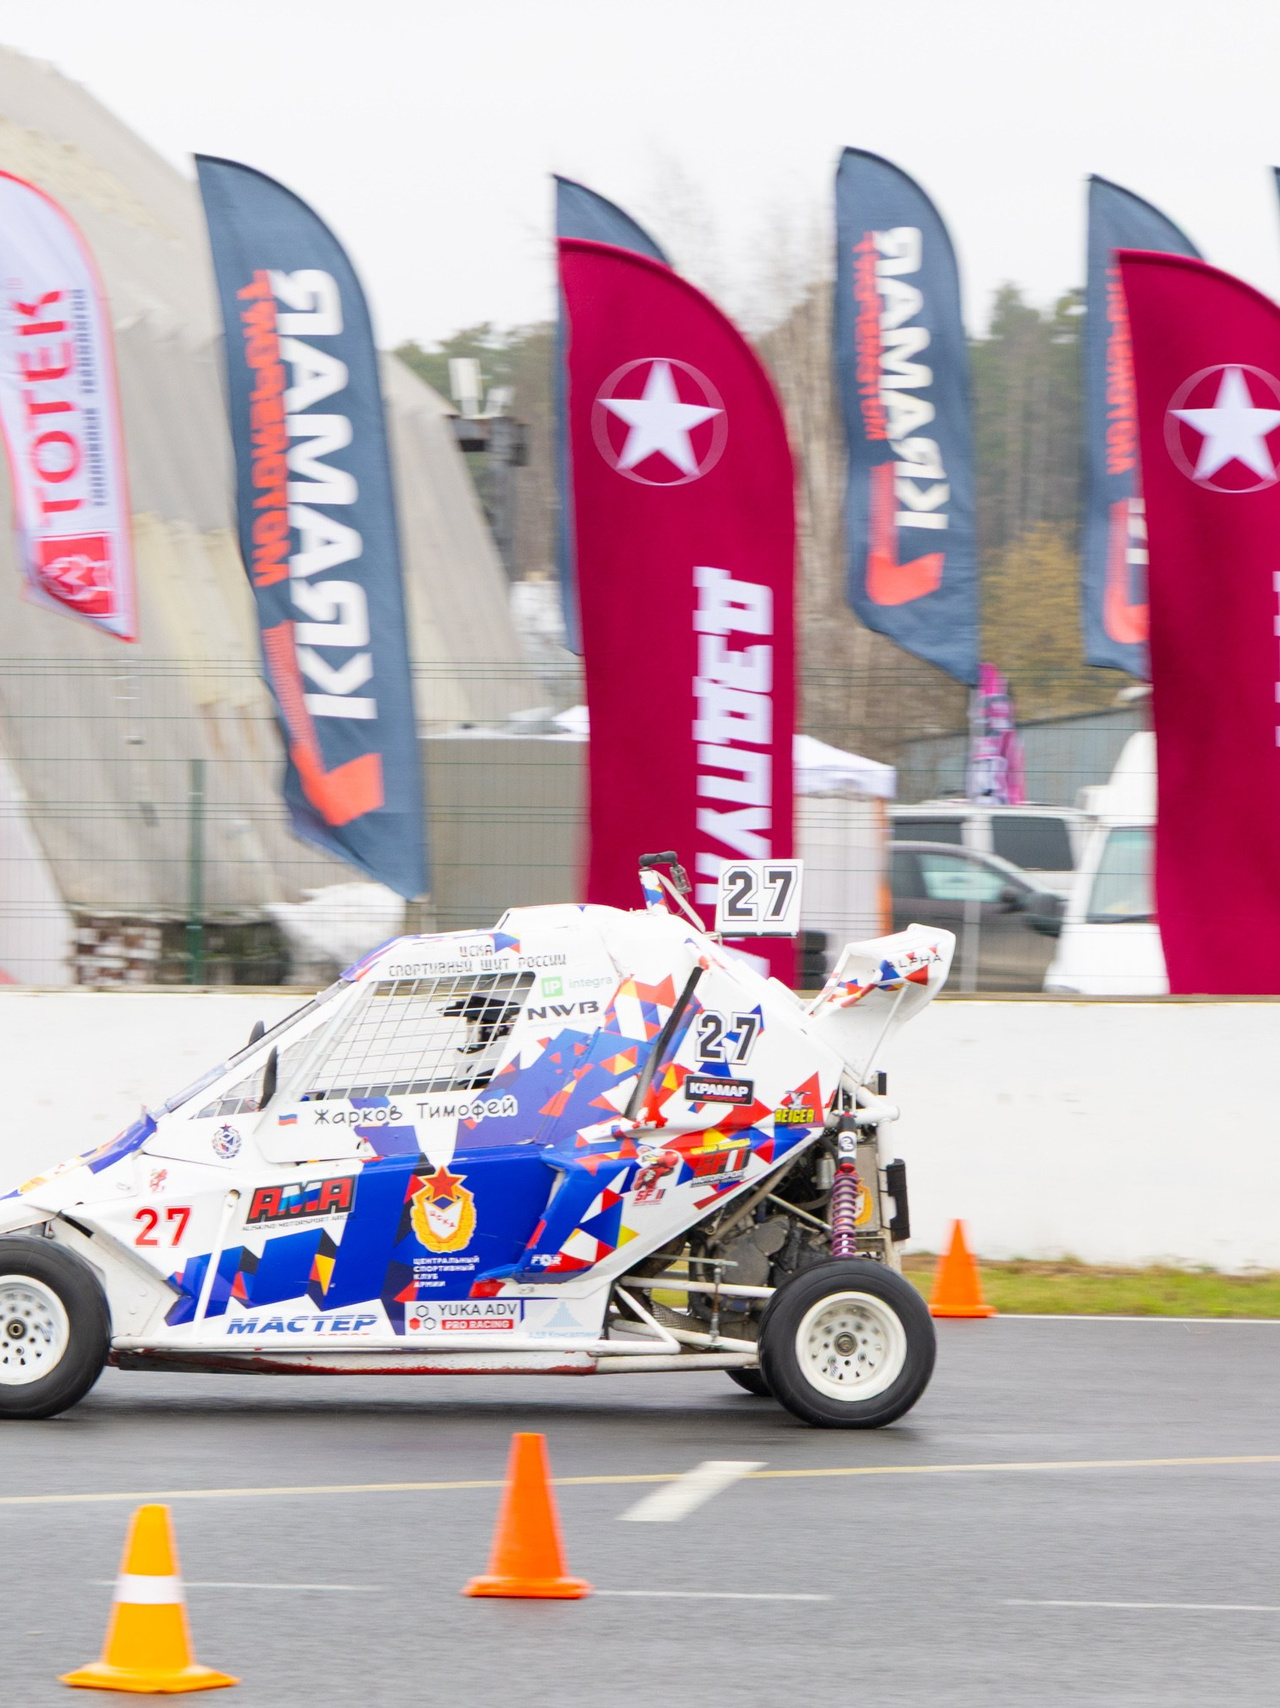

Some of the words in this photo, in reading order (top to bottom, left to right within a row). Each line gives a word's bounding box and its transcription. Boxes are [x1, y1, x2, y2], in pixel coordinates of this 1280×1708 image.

[724, 868, 797, 920] 27
[887, 954, 943, 968] ALPHA
[569, 976, 613, 989] integra
[527, 1000, 599, 1020] NWB
[697, 1011, 759, 1063] 27
[689, 1082, 749, 1097] КРАМАР
[314, 1105, 403, 1127] Жарков
[416, 1098, 515, 1120] Тимофей
[249, 1178, 353, 1219] AMA
[133, 1205, 193, 1248] 27
[413, 1256, 480, 1265] ЦЕНТРАЛЬНЫЙ
[413, 1264, 475, 1273] СПОРТИВНЫЙ
[413, 1280, 445, 1288] АРМИИ
[438, 1304, 481, 1316] YUKA
[485, 1303, 518, 1315] ADV
[445, 1320, 467, 1330] PRO
[469, 1319, 510, 1329] RACING
